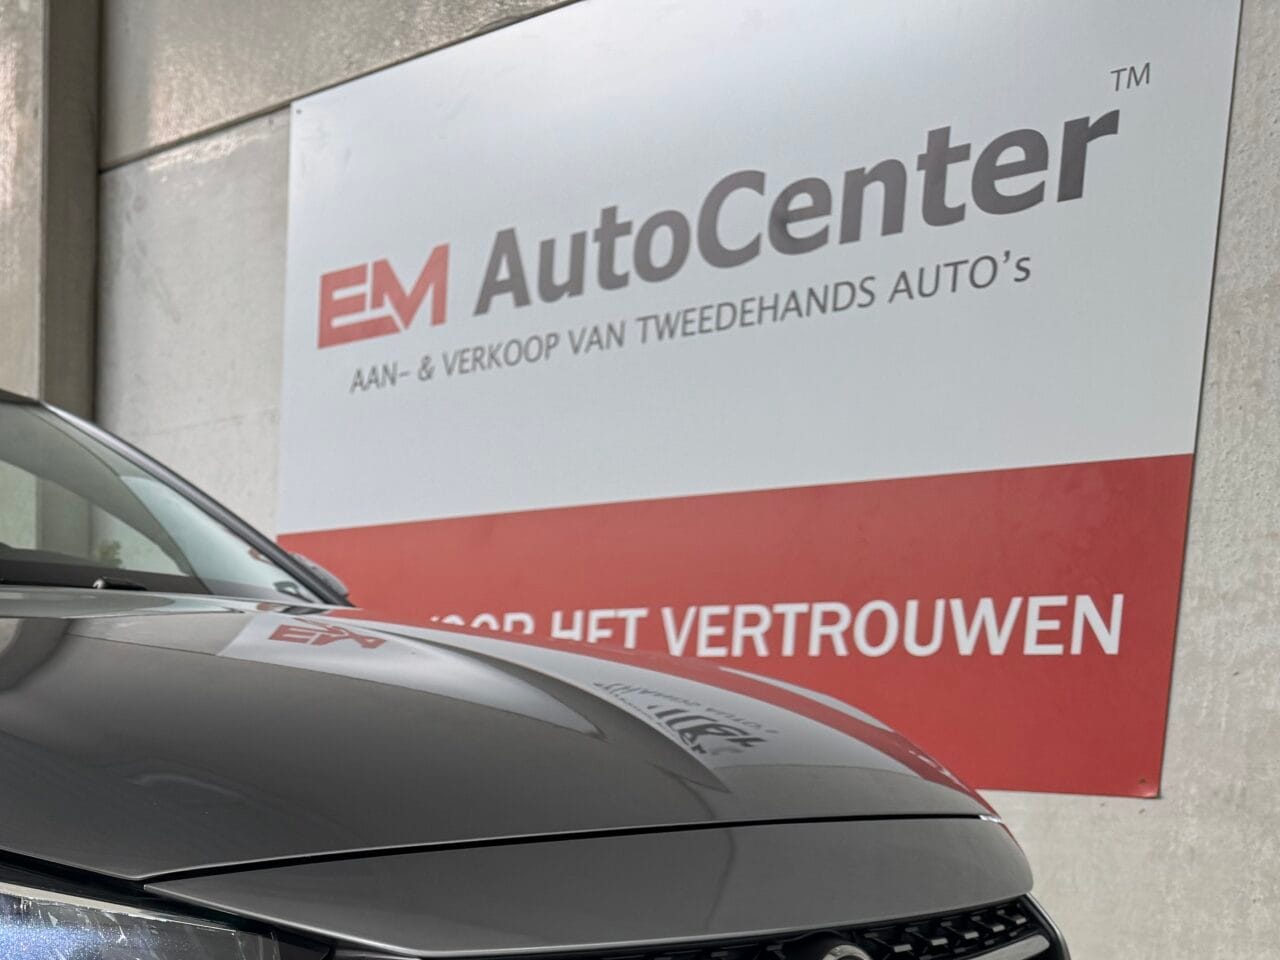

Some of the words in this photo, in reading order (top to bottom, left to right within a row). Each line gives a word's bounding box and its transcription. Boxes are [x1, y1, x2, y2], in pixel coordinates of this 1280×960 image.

[1110, 62, 1151, 92] TM
[317, 244, 450, 350] EM
[473, 109, 1120, 316] AutoCenter
[349, 361, 410, 395] AAN-
[417, 353, 436, 382] &
[442, 332, 561, 378] VERKOOP
[568, 320, 626, 356] VAN
[636, 275, 877, 344] TWEEDEHANDS
[660, 593, 1124, 658] VERTROUWEN
